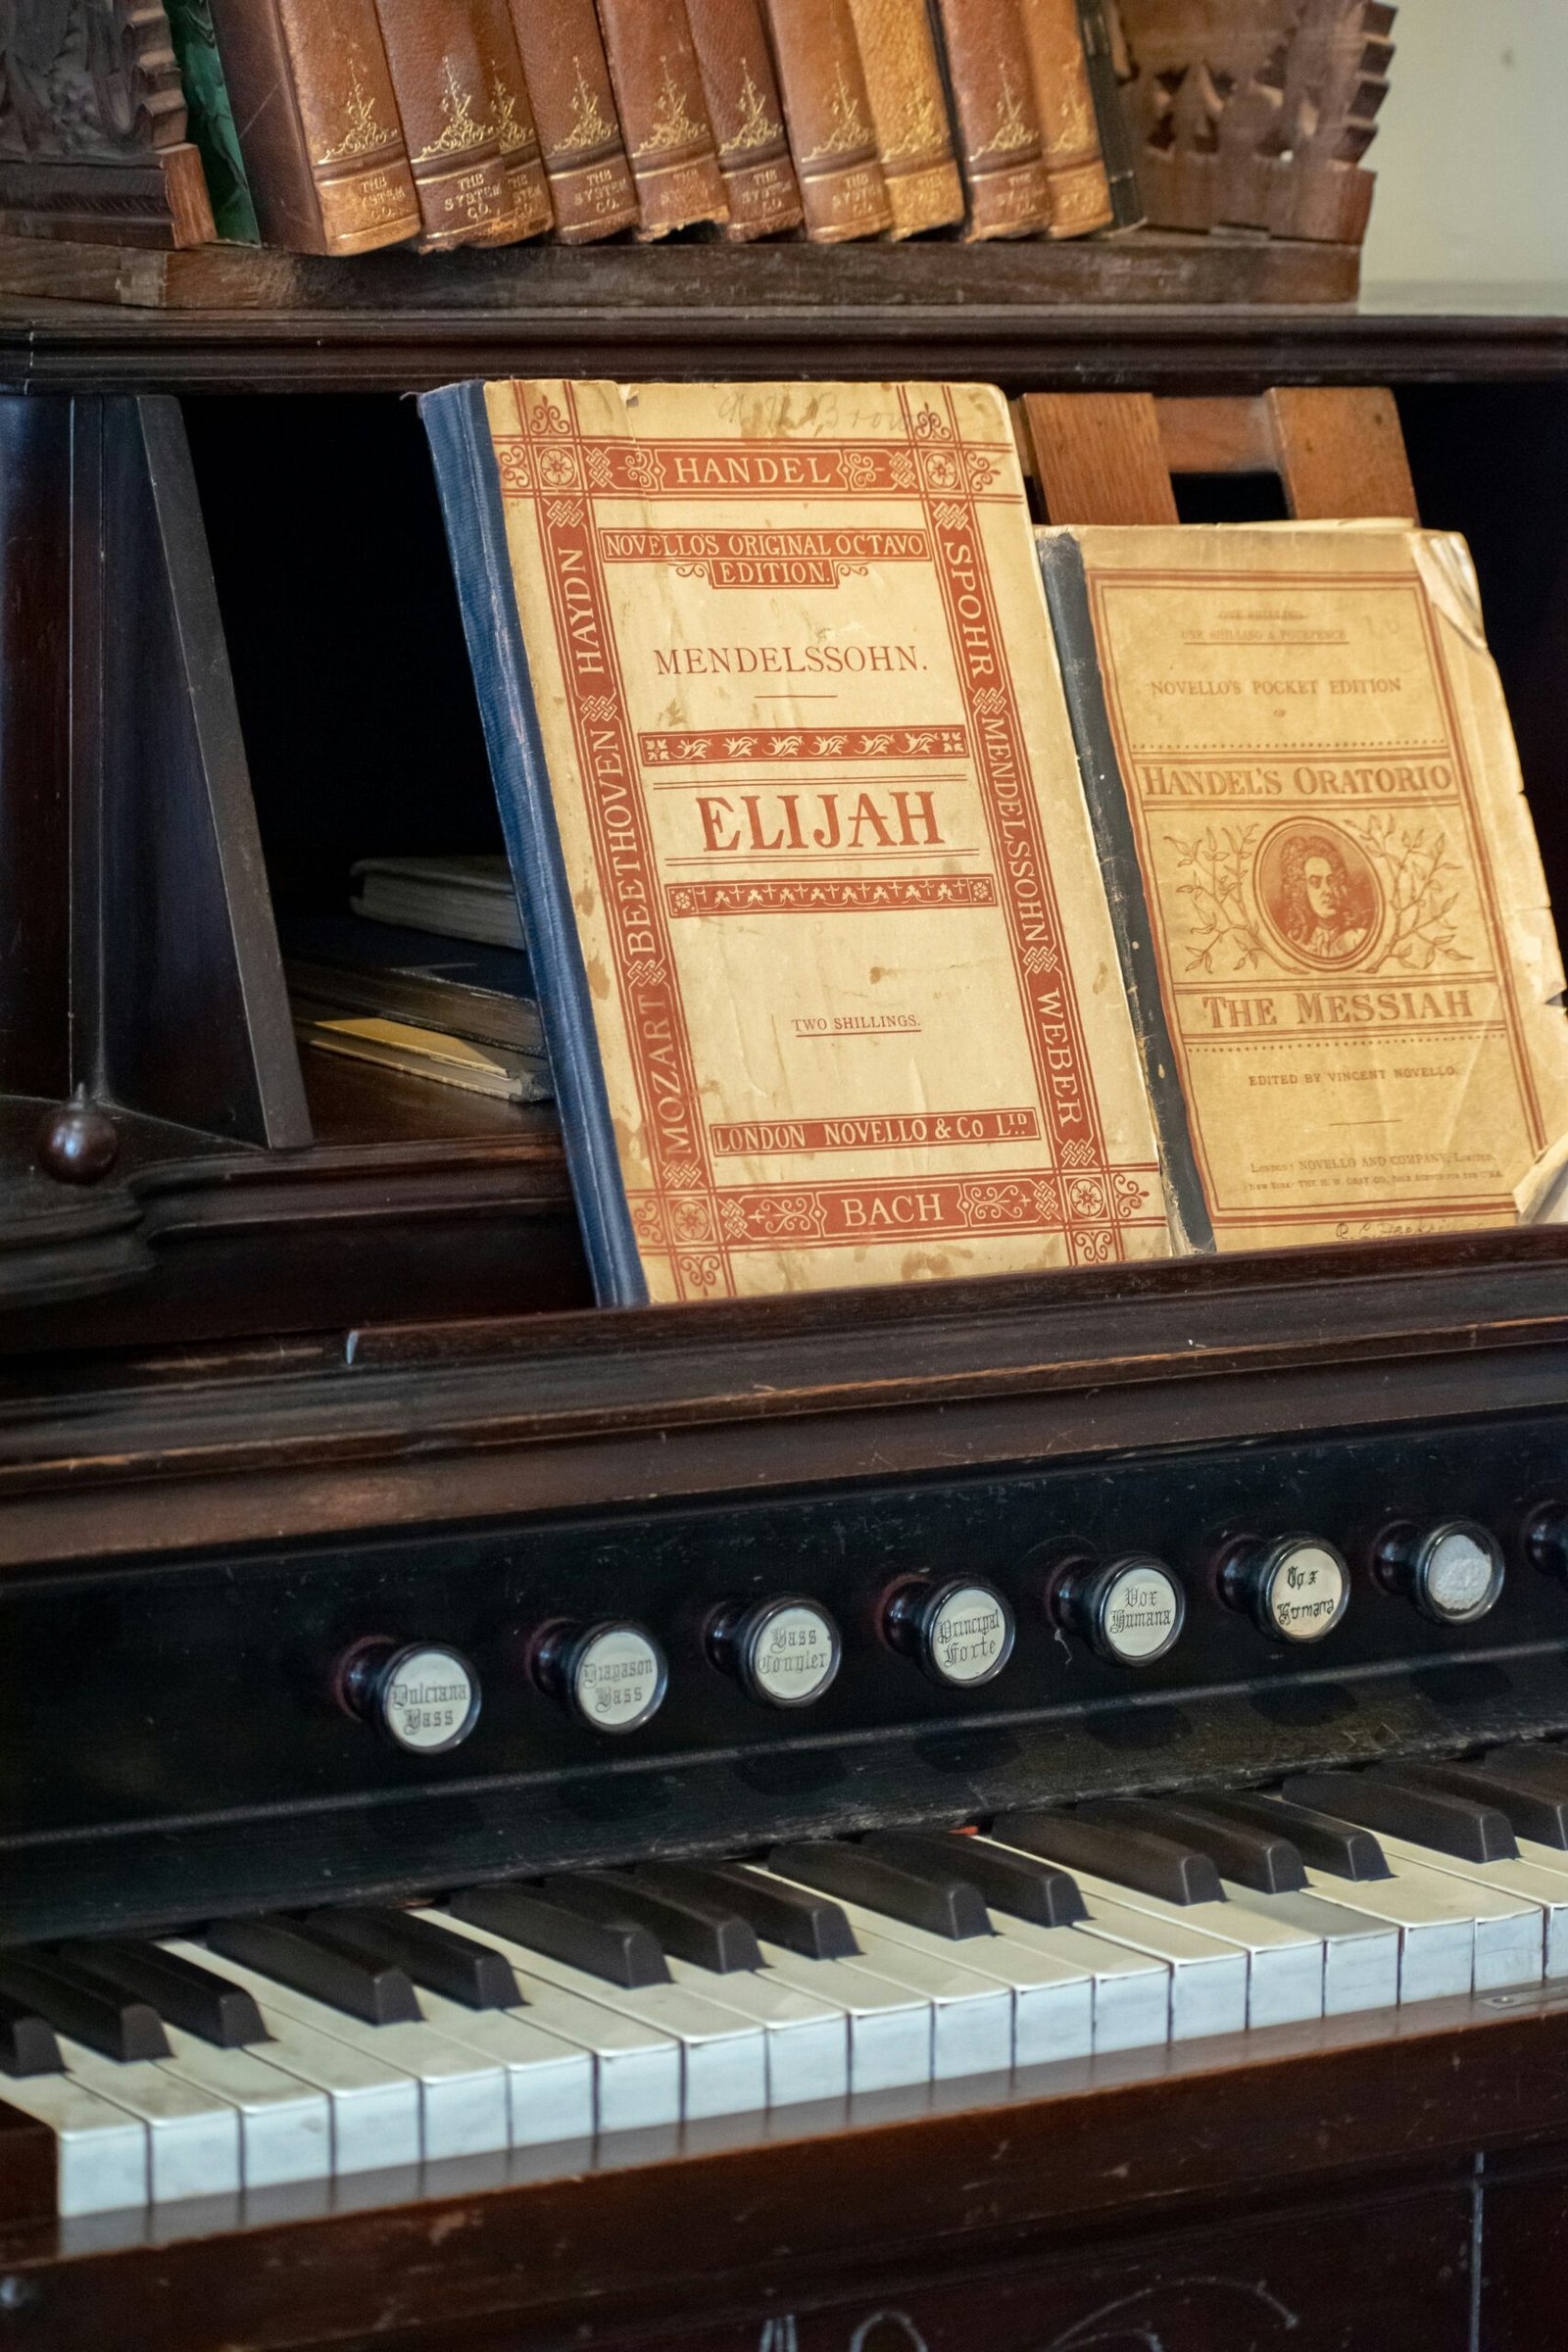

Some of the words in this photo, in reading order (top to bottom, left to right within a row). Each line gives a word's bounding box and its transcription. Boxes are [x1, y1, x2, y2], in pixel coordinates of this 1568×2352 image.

[457, 173, 485, 192] THE
[586, 169, 613, 187] THE
[443, 184, 504, 211] SYSTEM
[674, 455, 832, 485] HANDEL
[606, 534, 720, 559] NOVELLO'S
[728, 533, 831, 557] ORIGINAL
[835, 533, 924, 557] OCTAVO
[720, 562, 831, 584] EDITION.
[557, 547, 605, 675] HAYDN
[943, 541, 996, 680] SPOHR
[653, 646, 929, 675] MENDELSSOHN.
[1151, 679, 1243, 697] NOVELLO'S
[1251, 678, 1319, 696] POCKET
[1329, 676, 1402, 695] EDITION
[1141, 764, 1284, 798] HANDEL'S
[1294, 763, 1453, 794] ORATORIO
[694, 790, 947, 853] ELIJAH
[981, 717, 1050, 944] MENDELSSOHN
[588, 728, 657, 957] BEETHOVEN
[791, 1017, 828, 1032] TWO
[833, 1014, 922, 1030] SHILLINGS.
[1202, 996, 1277, 1029] THE
[1292, 989, 1474, 1025] MESSIAH
[1036, 990, 1085, 1127] WEBER
[640, 994, 693, 1155] MOZART
[1248, 1074, 1299, 1087] EDITED
[1304, 1072, 1322, 1084] BY
[1327, 1069, 1388, 1083] VINCENT
[717, 1124, 807, 1152] LONDON
[824, 1118, 928, 1147] NOVELLO
[934, 1117, 953, 1139] &
[1298, 1157, 1357, 1171] NOVELLO
[841, 1191, 947, 1230] BACH
[1288, 1566, 1319, 1590] Vox
[1124, 1587, 1158, 1607] Vox
[938, 1608, 1001, 1643] Principal
[1109, 1608, 1172, 1635] Humana
[769, 1627, 817, 1654] Bass
[943, 1636, 998, 1668] Forte
[582, 1657, 654, 1689] Diapason
[757, 1650, 828, 1675] Coupler
[392, 1682, 468, 1711] Dulciana
[595, 1686, 644, 1714] Bass
[403, 1707, 455, 1737] Bass
